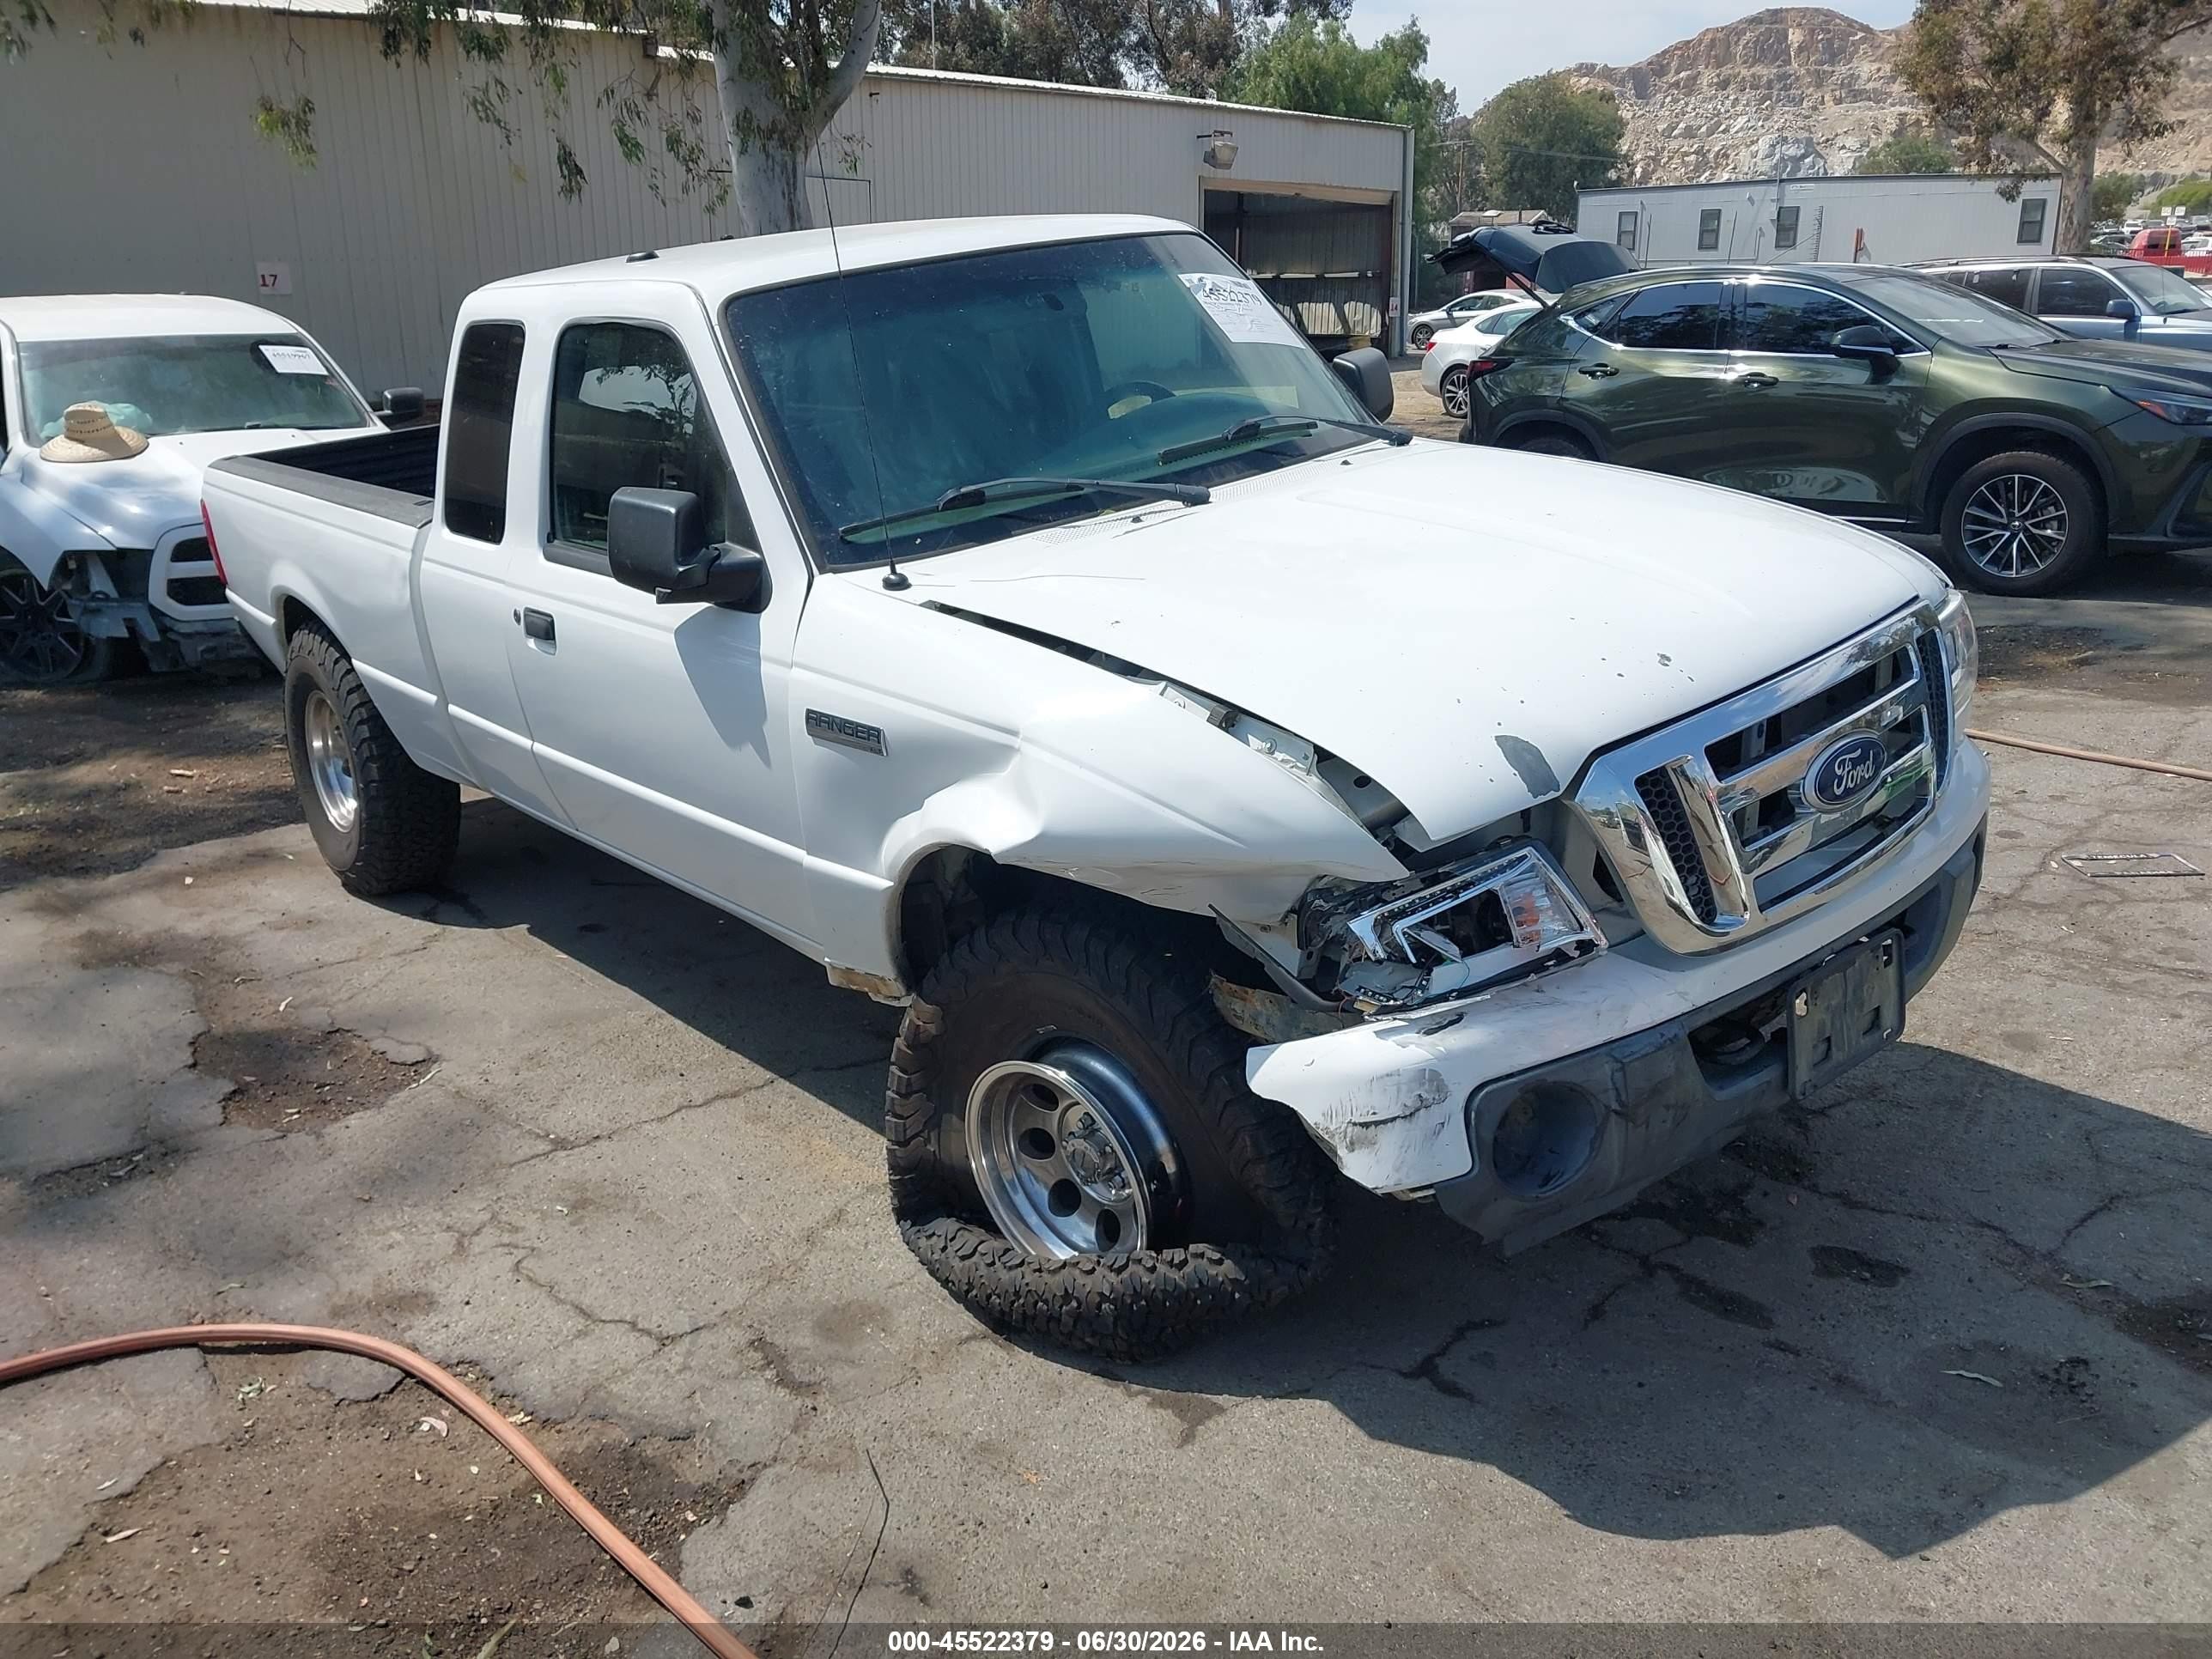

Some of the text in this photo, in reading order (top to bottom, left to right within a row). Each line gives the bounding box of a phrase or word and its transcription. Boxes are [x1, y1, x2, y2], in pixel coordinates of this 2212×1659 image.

[259, 274, 278, 288] 17
[1201, 285, 1262, 306] 45522379
[1390, 303, 1399, 312] 14
[807, 712, 881, 744] RANGER
[1833, 747, 1876, 796] Ford
